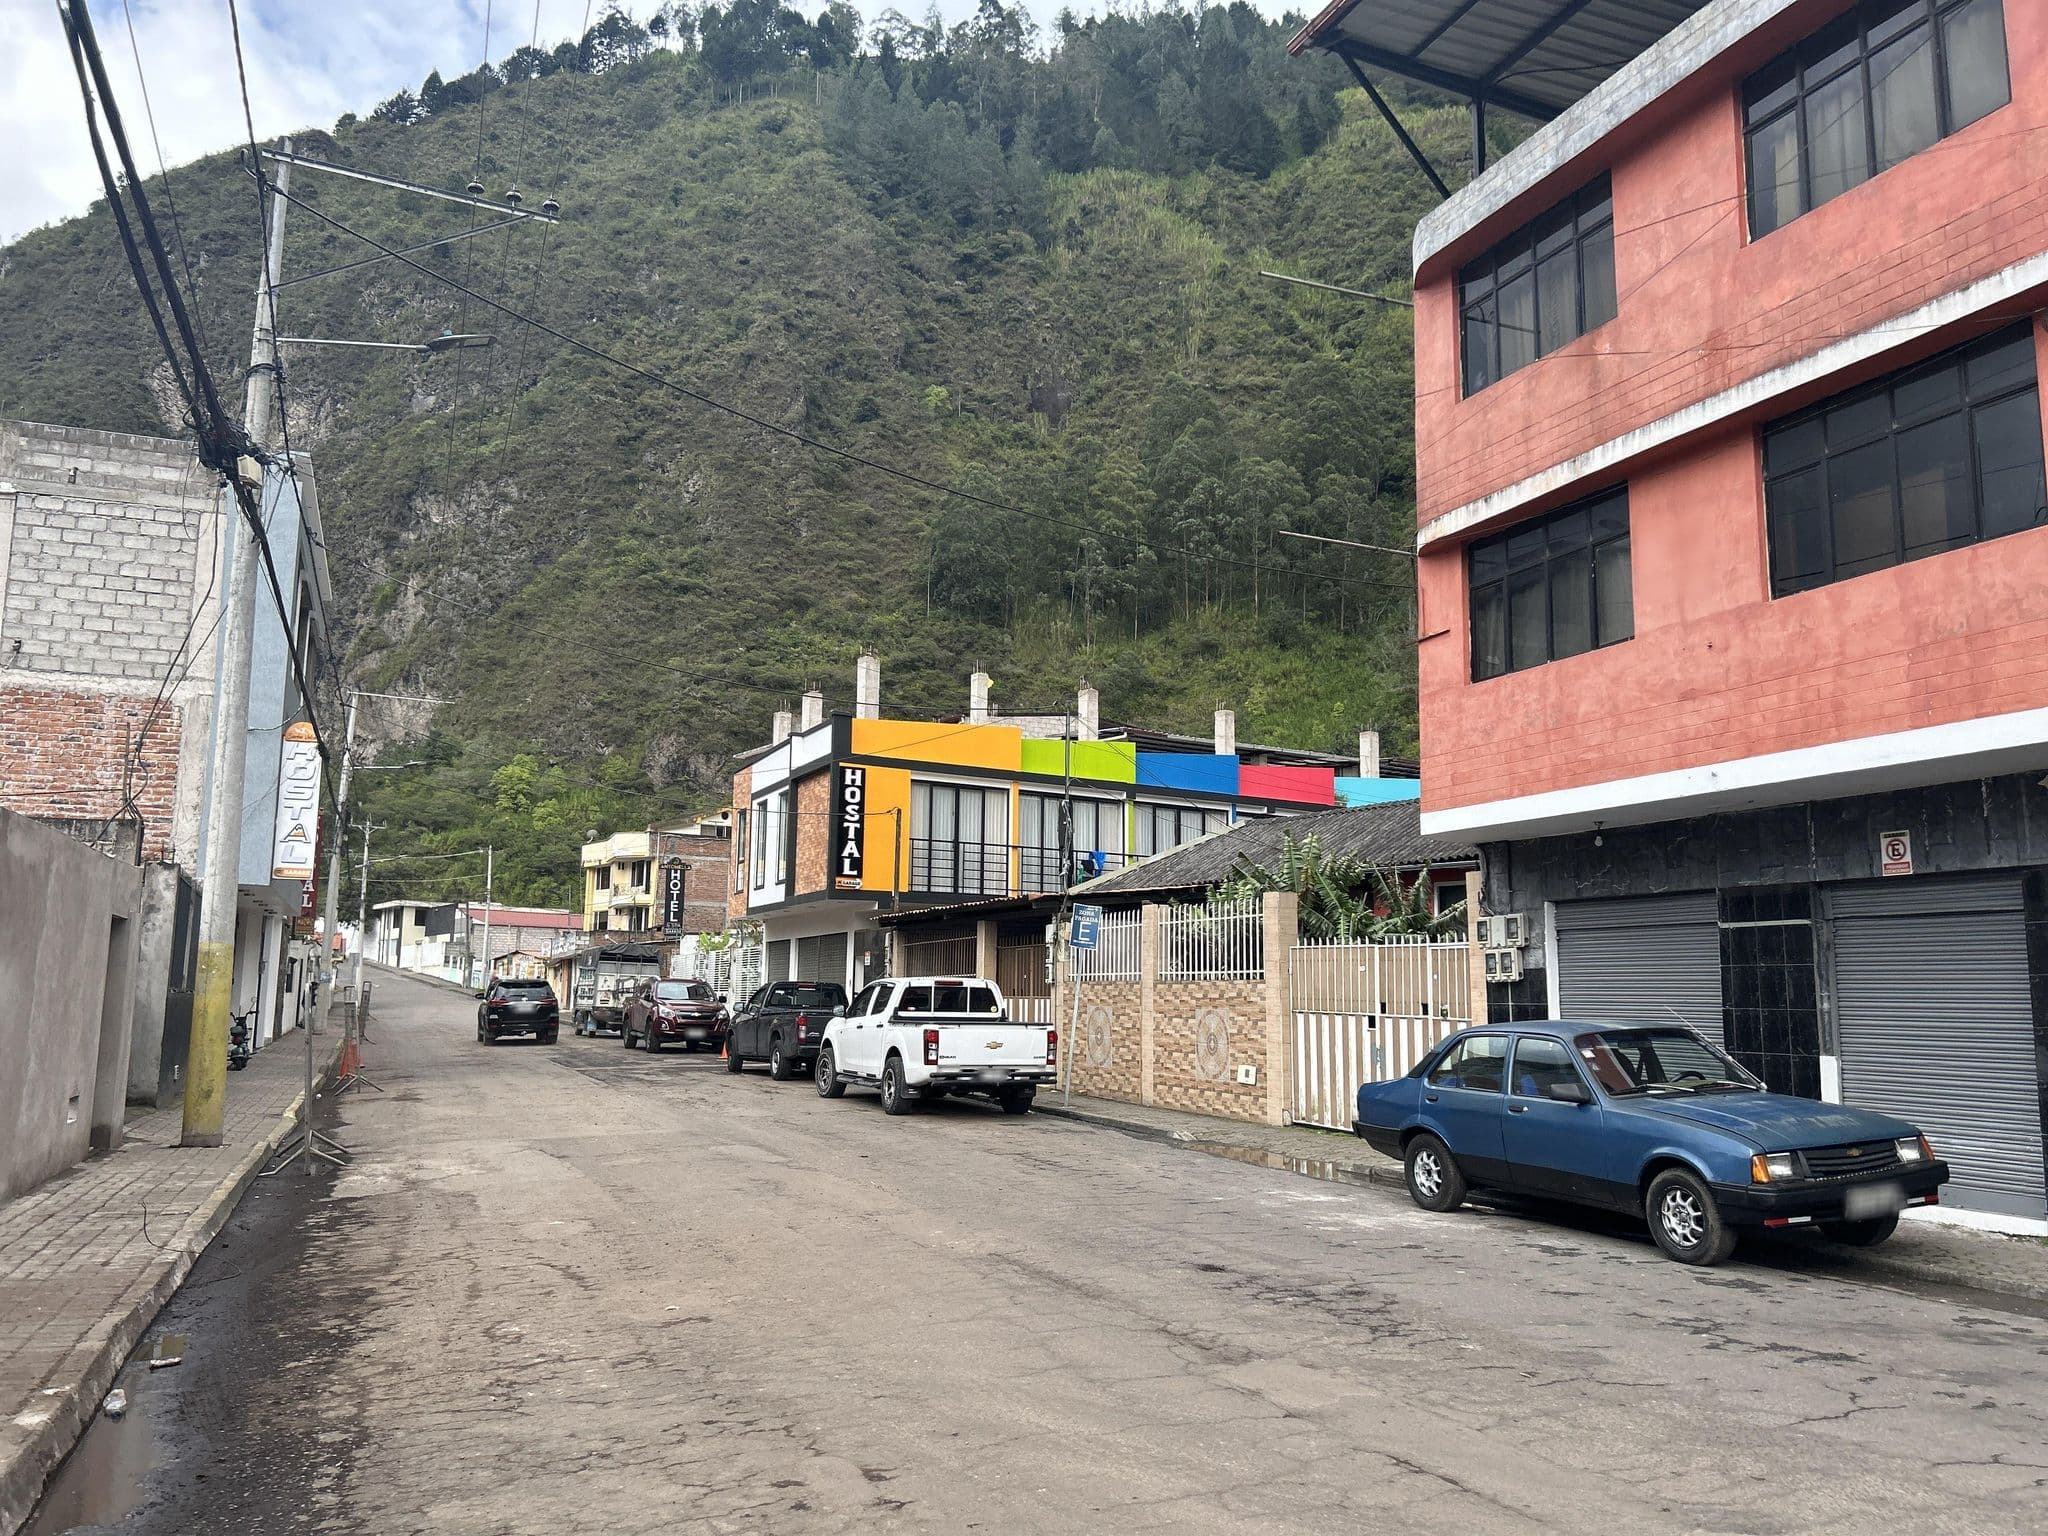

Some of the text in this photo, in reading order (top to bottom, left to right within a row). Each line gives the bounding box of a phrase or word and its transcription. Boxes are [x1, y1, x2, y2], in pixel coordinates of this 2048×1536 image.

[280, 742, 317, 864] HOSTAL
[841, 768, 862, 875] HOSTAL
[670, 869, 681, 922] HOTEL
[1078, 921, 1092, 941] E
